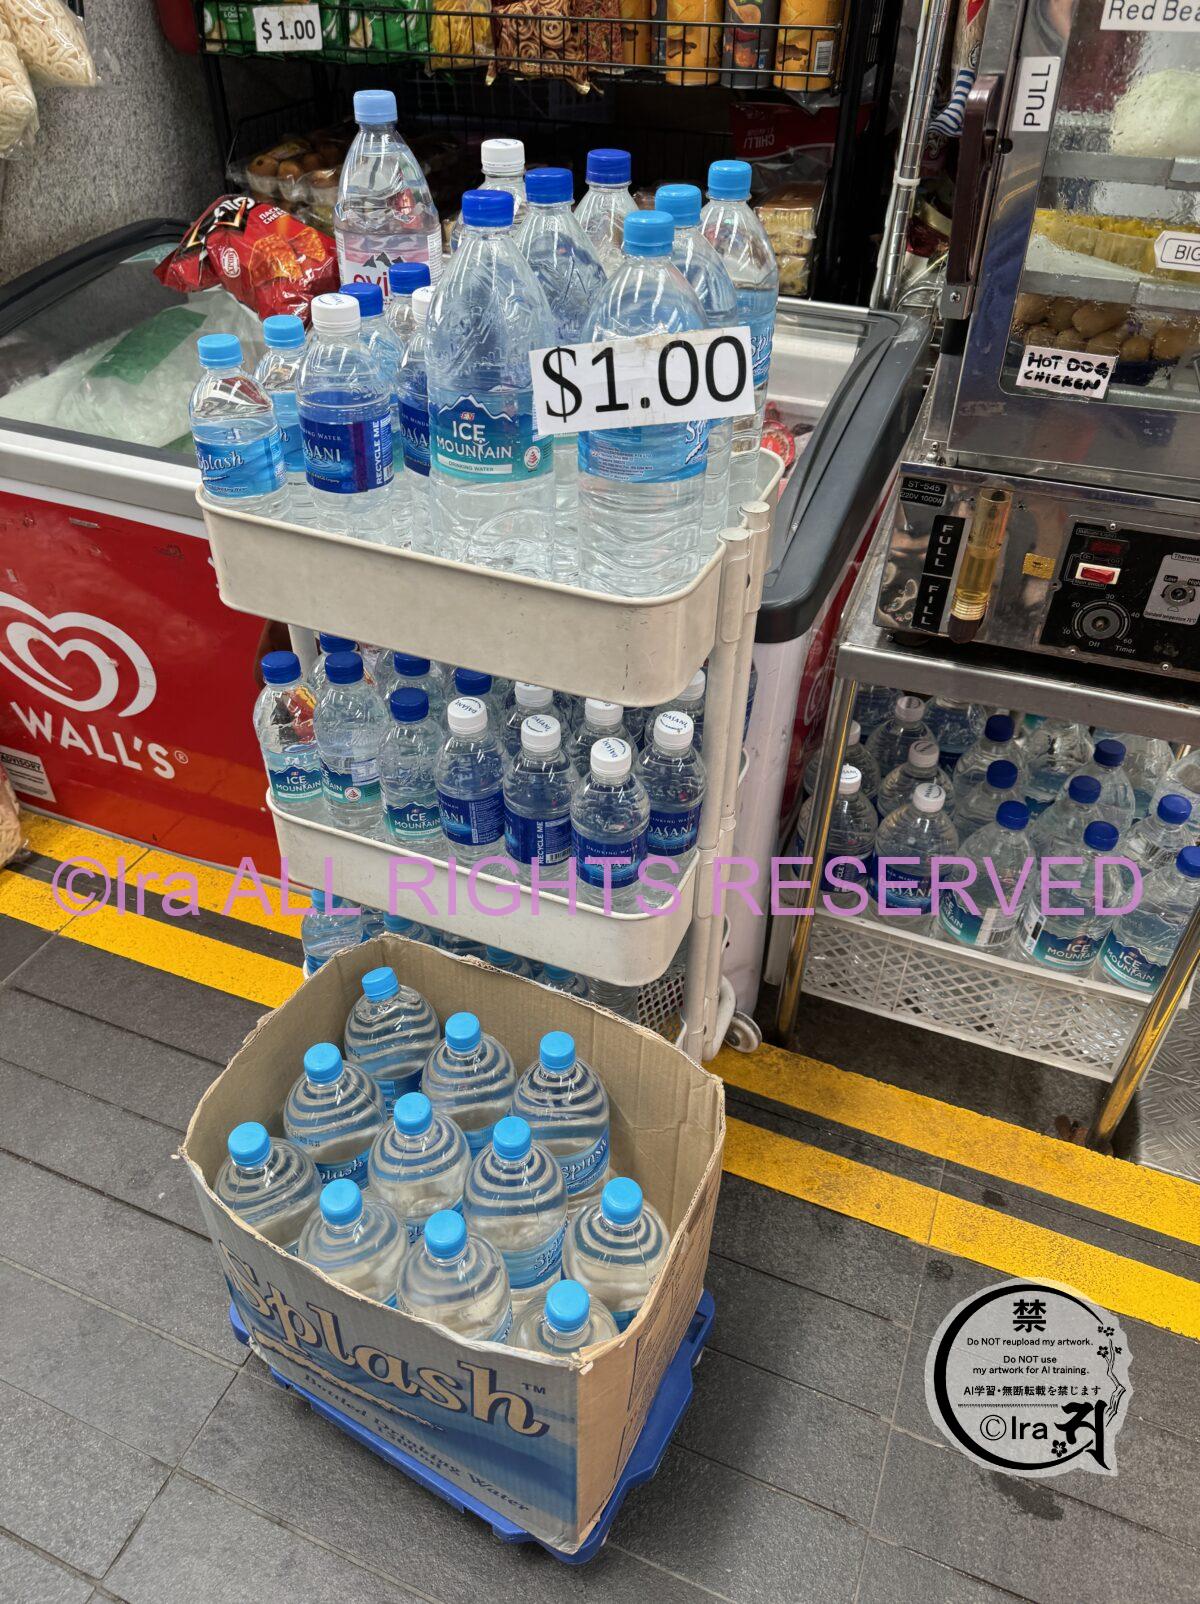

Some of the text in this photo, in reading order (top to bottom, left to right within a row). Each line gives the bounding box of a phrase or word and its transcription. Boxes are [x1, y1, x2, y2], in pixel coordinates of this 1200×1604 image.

[1108, 0, 1157, 20] Red
[261, 18, 316, 43] $ 1.00
[1023, 63, 1051, 127] PULL
[541, 334, 748, 423] $1.00
[1066, 358, 1110, 379] DOG
[1023, 370, 1101, 391] CHICKEN
[400, 423, 430, 448] DASA
[452, 420, 486, 441] ICE
[372, 420, 384, 485] RECYCLE ME
[436, 435, 512, 460] MOUNTAIN
[448, 460, 473, 471] DRINKING
[907, 481, 941, 492] ST-545
[934, 524, 954, 567] FULL
[921, 584, 940, 626] FILL
[1088, 640, 1101, 648] Off
[1115, 645, 1136, 654] Timer
[10, 701, 175, 780] WALL'S
[275, 780, 321, 792] MOUNTAIN
[286, 775, 307, 785] ICE
[394, 817, 440, 829] MOUNTAIN
[406, 812, 427, 822] ICE
[536, 821, 545, 865] RECYCLE ME
[1066, 943, 1091, 953] ICE
[1106, 947, 1155, 982] MOUNTAIN
[1118, 951, 1142, 968] ICE
[218, 1239, 550, 1438] Splash
[468, 1472, 529, 1511] Water
